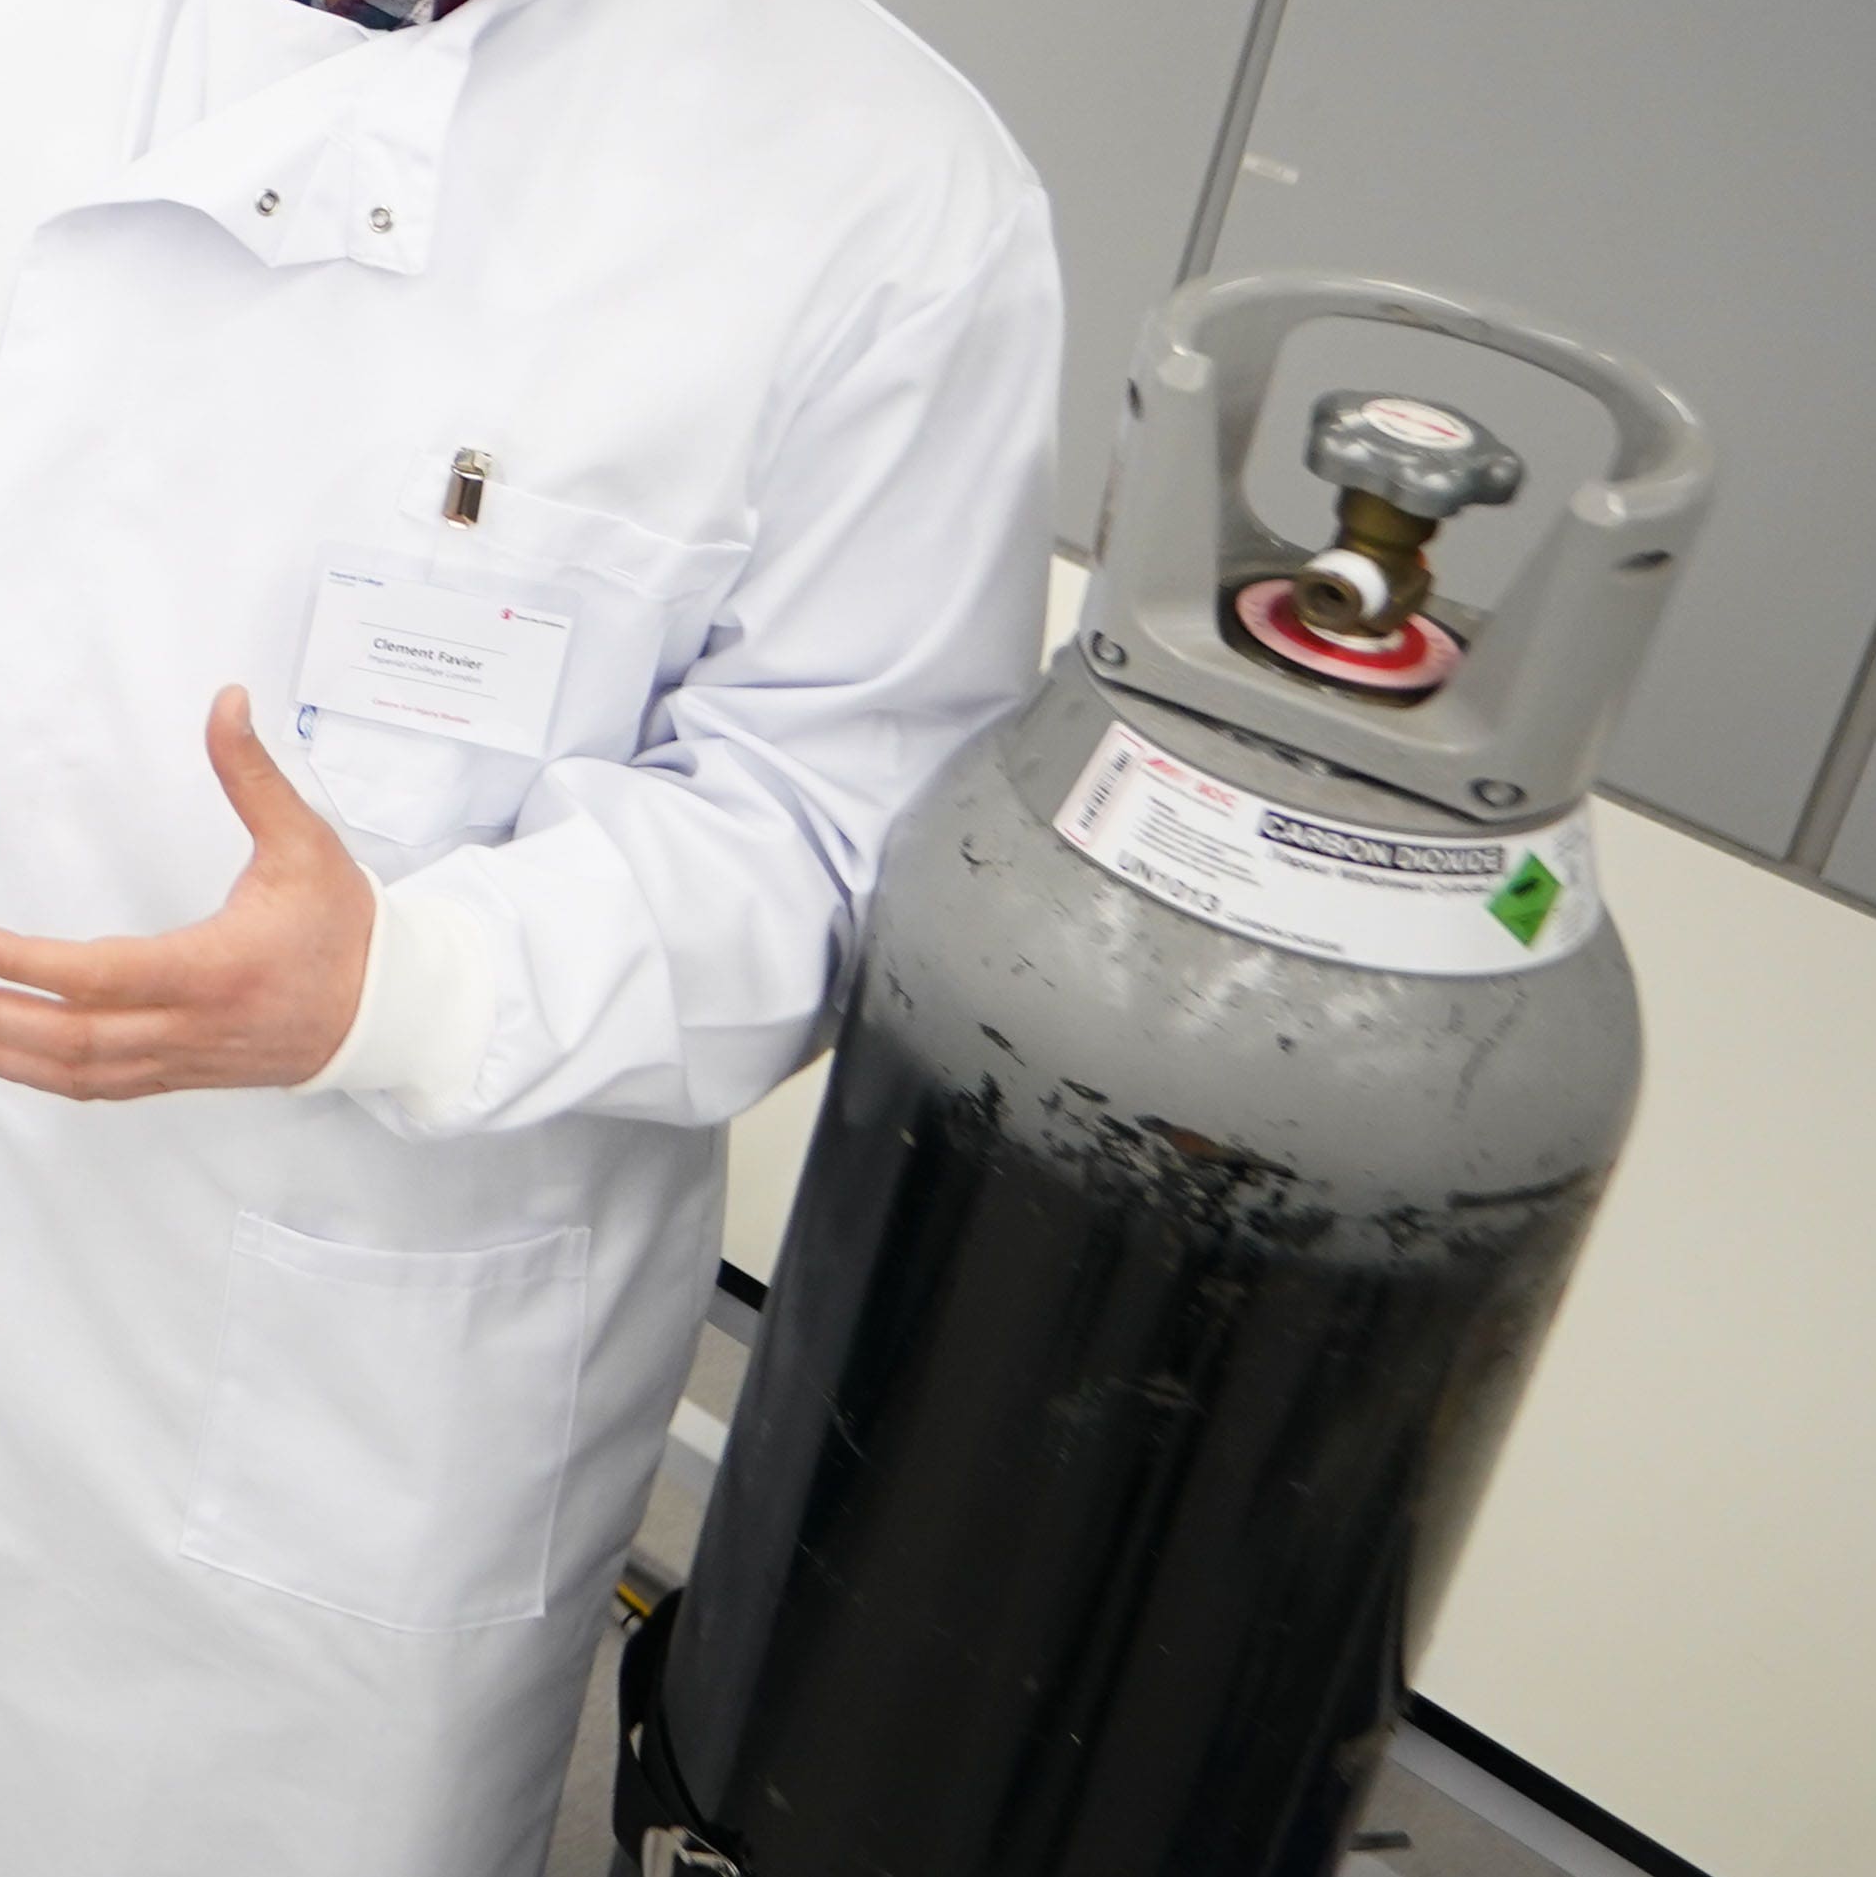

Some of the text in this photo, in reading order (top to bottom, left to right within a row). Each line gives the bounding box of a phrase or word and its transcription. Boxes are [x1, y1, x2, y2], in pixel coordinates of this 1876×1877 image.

[373, 637, 483, 671] Clement Favier
[1261, 812, 1394, 868] CARBON
[1396, 844, 1503, 874] DIOXIDE
